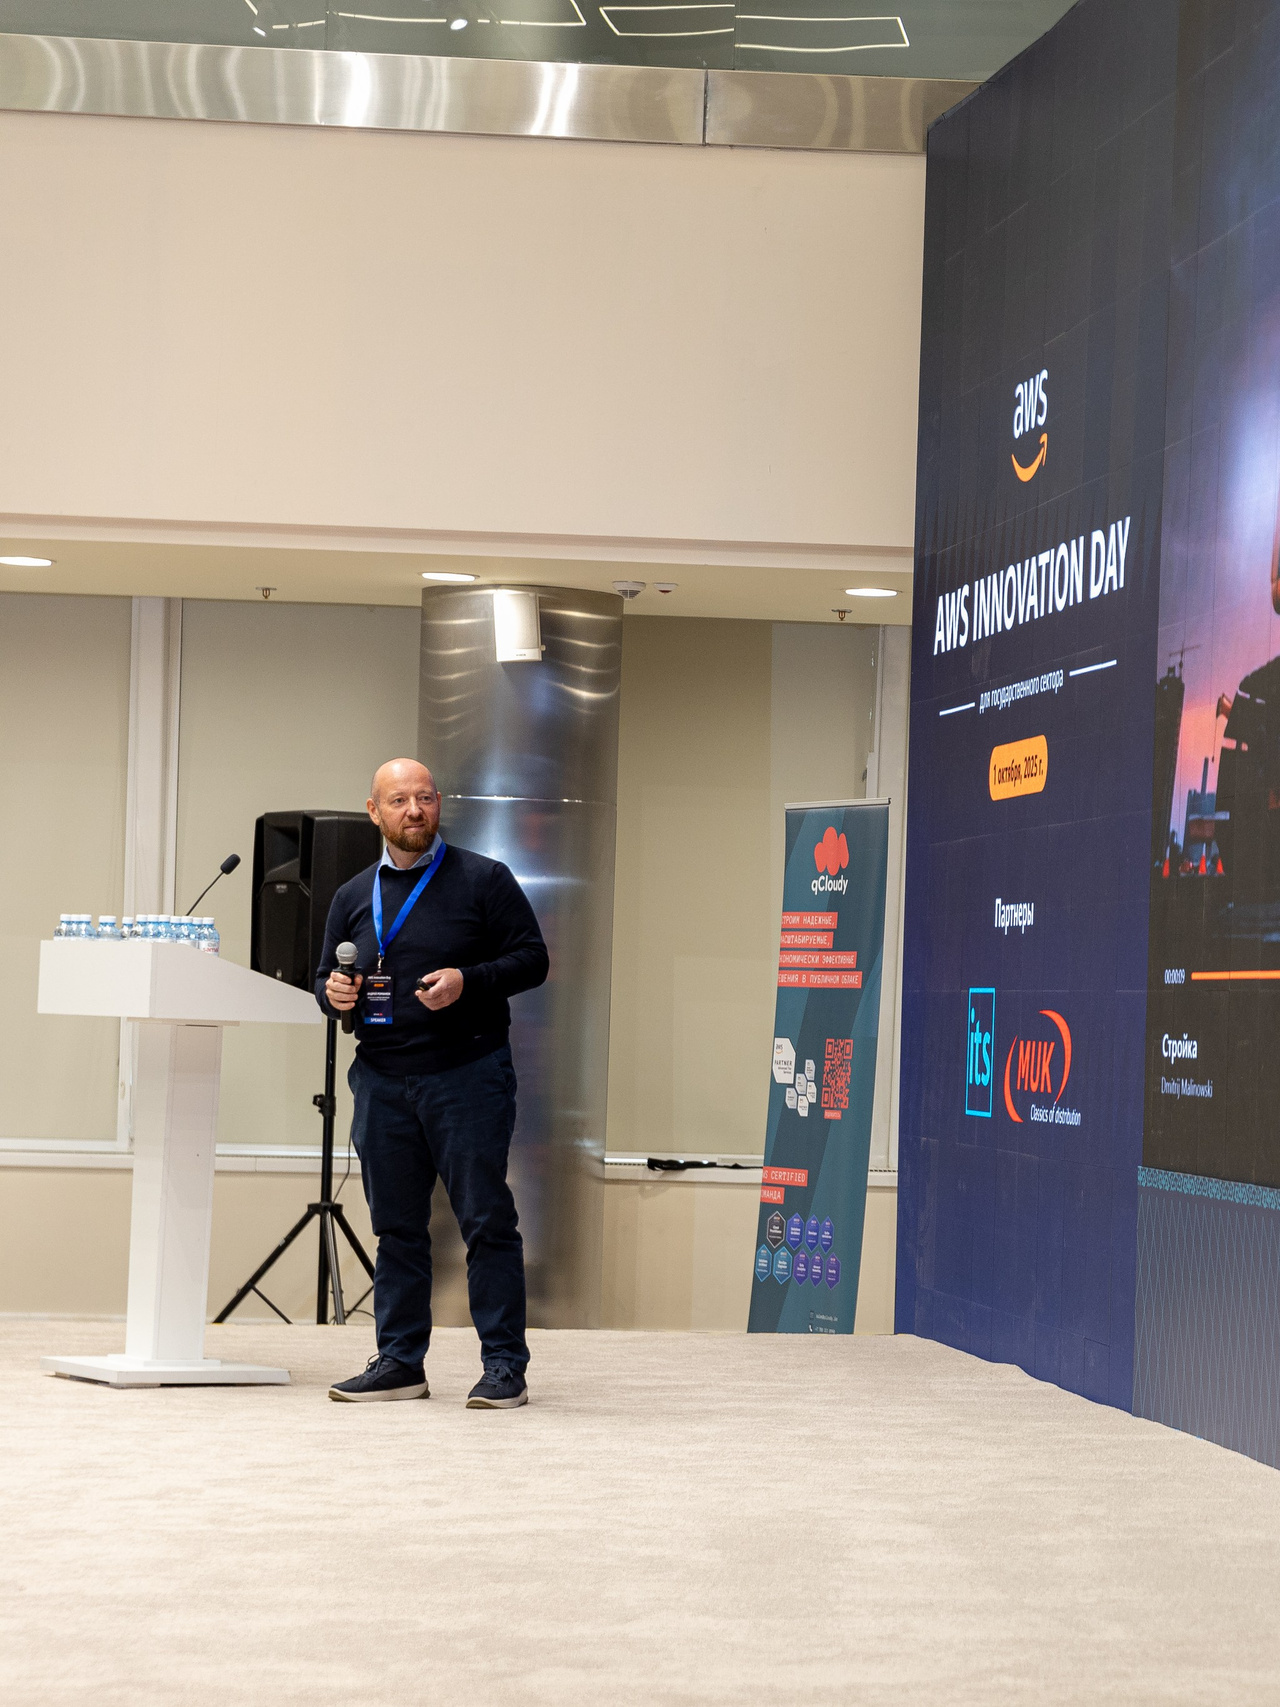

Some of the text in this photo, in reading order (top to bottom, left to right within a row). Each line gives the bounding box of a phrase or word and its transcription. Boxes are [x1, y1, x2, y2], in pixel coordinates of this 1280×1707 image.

[1013, 368, 1048, 439] aws
[934, 516, 1131, 656] AWS INNOVATION DAY
[979, 669, 1064, 714] для государственного сектора
[993, 754, 1044, 787] 1 октября, 2025 г.
[811, 875, 848, 895] qCloudy
[802, 915, 835, 927] НАДЕЖНЫЕ,
[994, 897, 1034, 935] Партнеры
[780, 934, 830, 947] АСШТАБИРУЕМЫЕ,
[779, 954, 819, 964] КОНОМИЧЕСКИ
[778, 973, 798, 983] ЕШЕНИЯ
[1164, 968, 1185, 984] 00:00:09
[968, 1007, 991, 1087] its
[1162, 1033, 1198, 1065] Стройка
[1016, 1040, 1055, 1094] MUK
[1161, 1076, 1213, 1100] Dmitrij Malinowski
[1030, 1101, 1081, 1126] Classics of distribution
[771, 1170, 805, 1183] CERTIFIED
